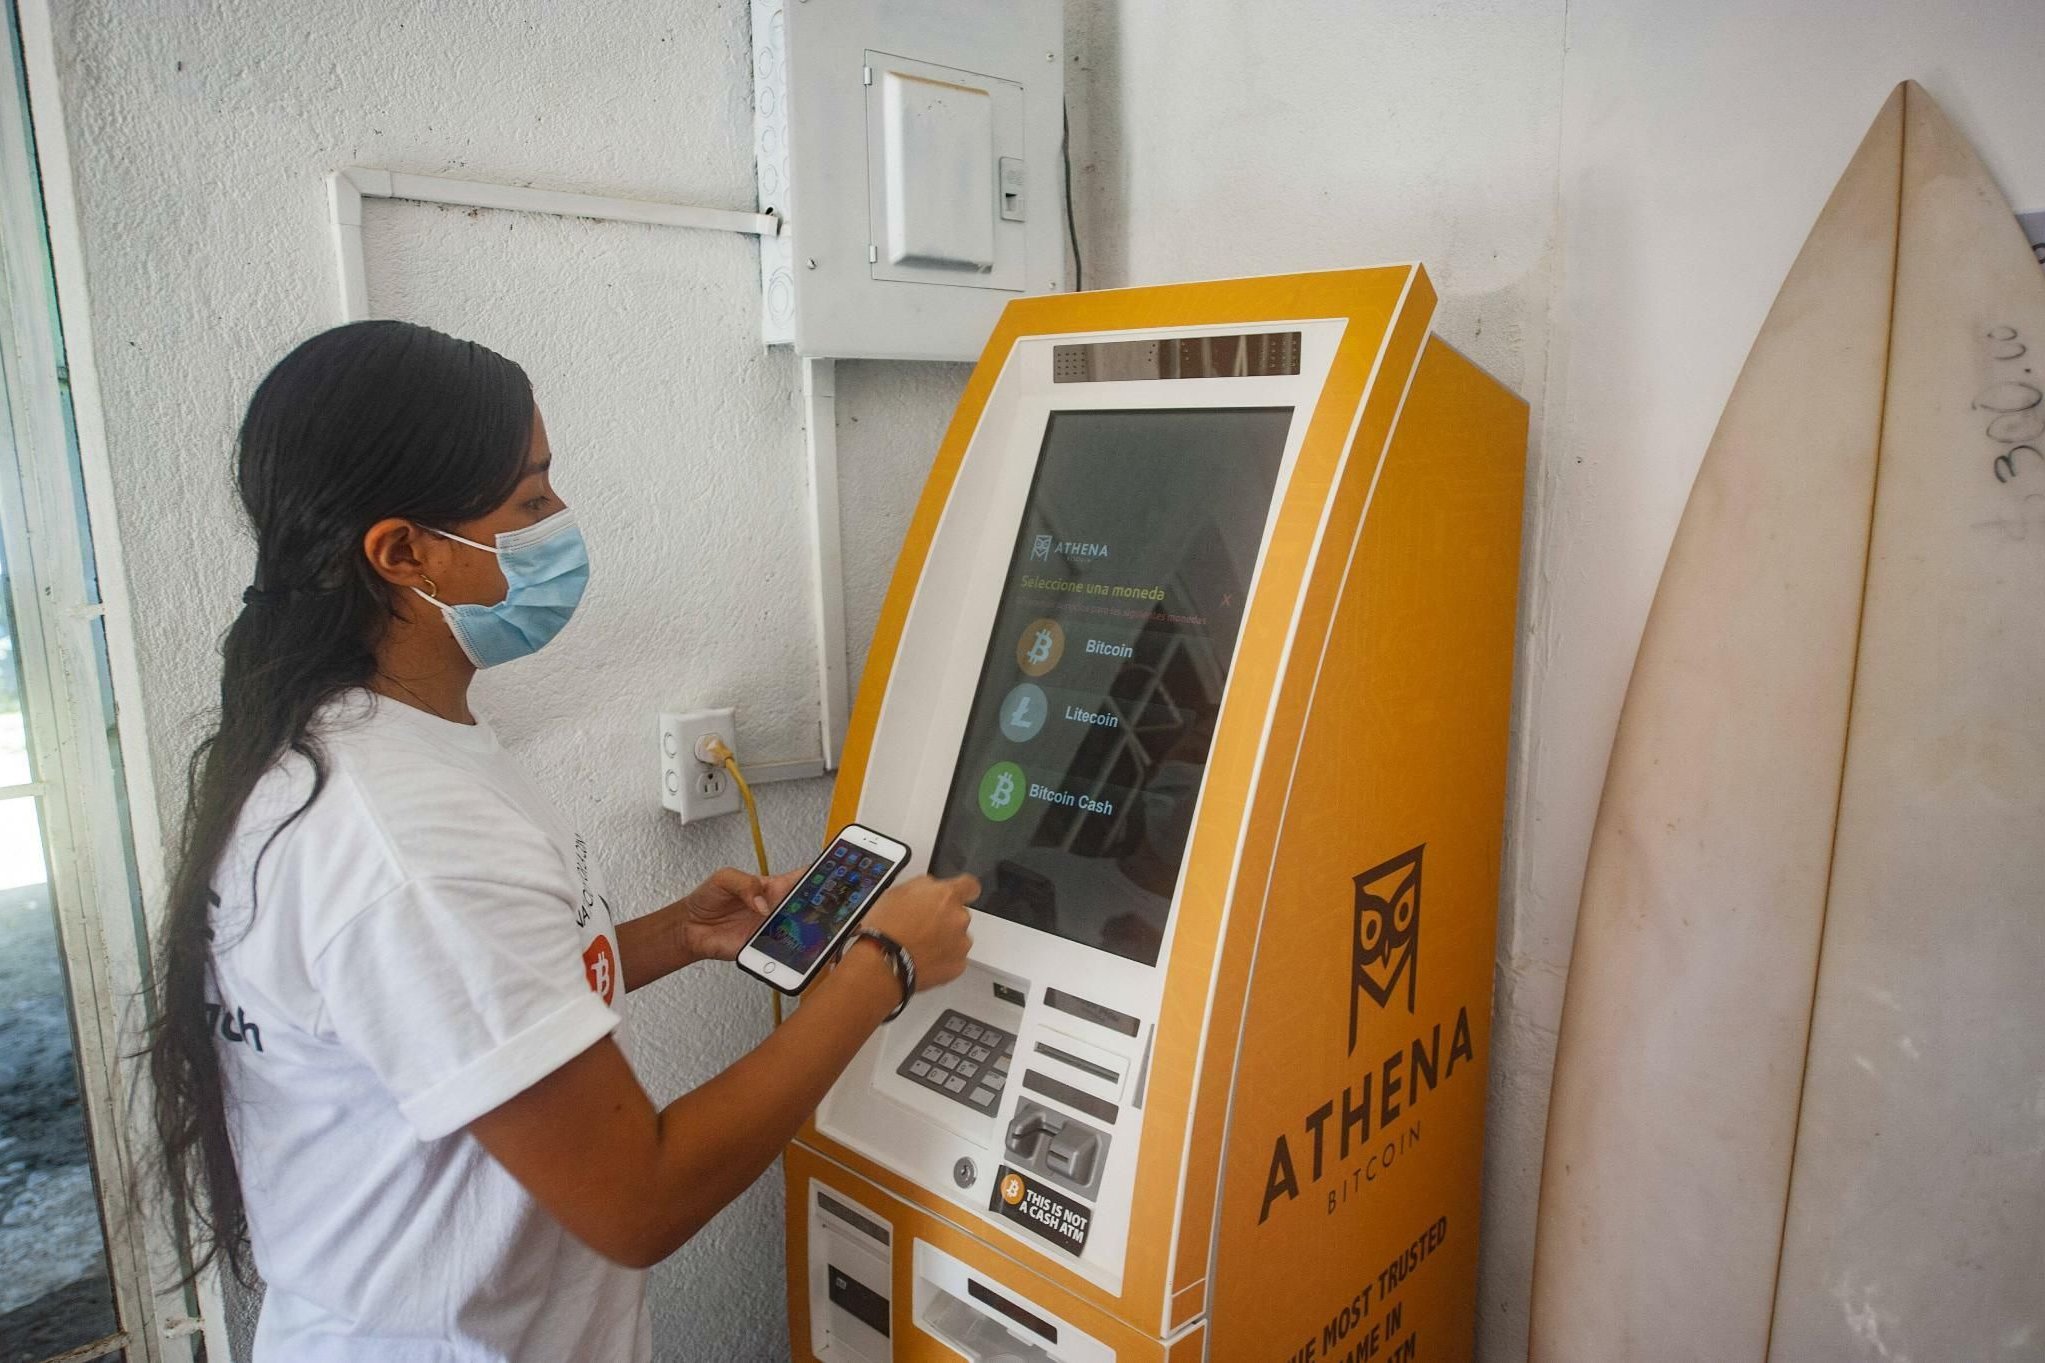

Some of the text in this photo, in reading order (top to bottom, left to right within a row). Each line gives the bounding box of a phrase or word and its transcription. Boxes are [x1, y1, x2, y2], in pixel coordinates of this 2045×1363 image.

[1055, 542, 1108, 557] ATHENA
[1022, 575, 1165, 601] Seleccione una moneda
[1086, 639, 1133, 658] Bitcoin
[1065, 705, 1118, 728] Litecoin
[1029, 783, 1113, 816] Bitcoin Cash
[1257, 1006, 1474, 1226] ATHENA
[1327, 1120, 1421, 1215] BITCOIN
[1019, 1201, 1085, 1244] A CASH ATM
[1026, 1189, 1088, 1230] THIS IS NOT
[1322, 1216, 1447, 1356] MOST TRUSTED
[1385, 1301, 1402, 1341] IN
